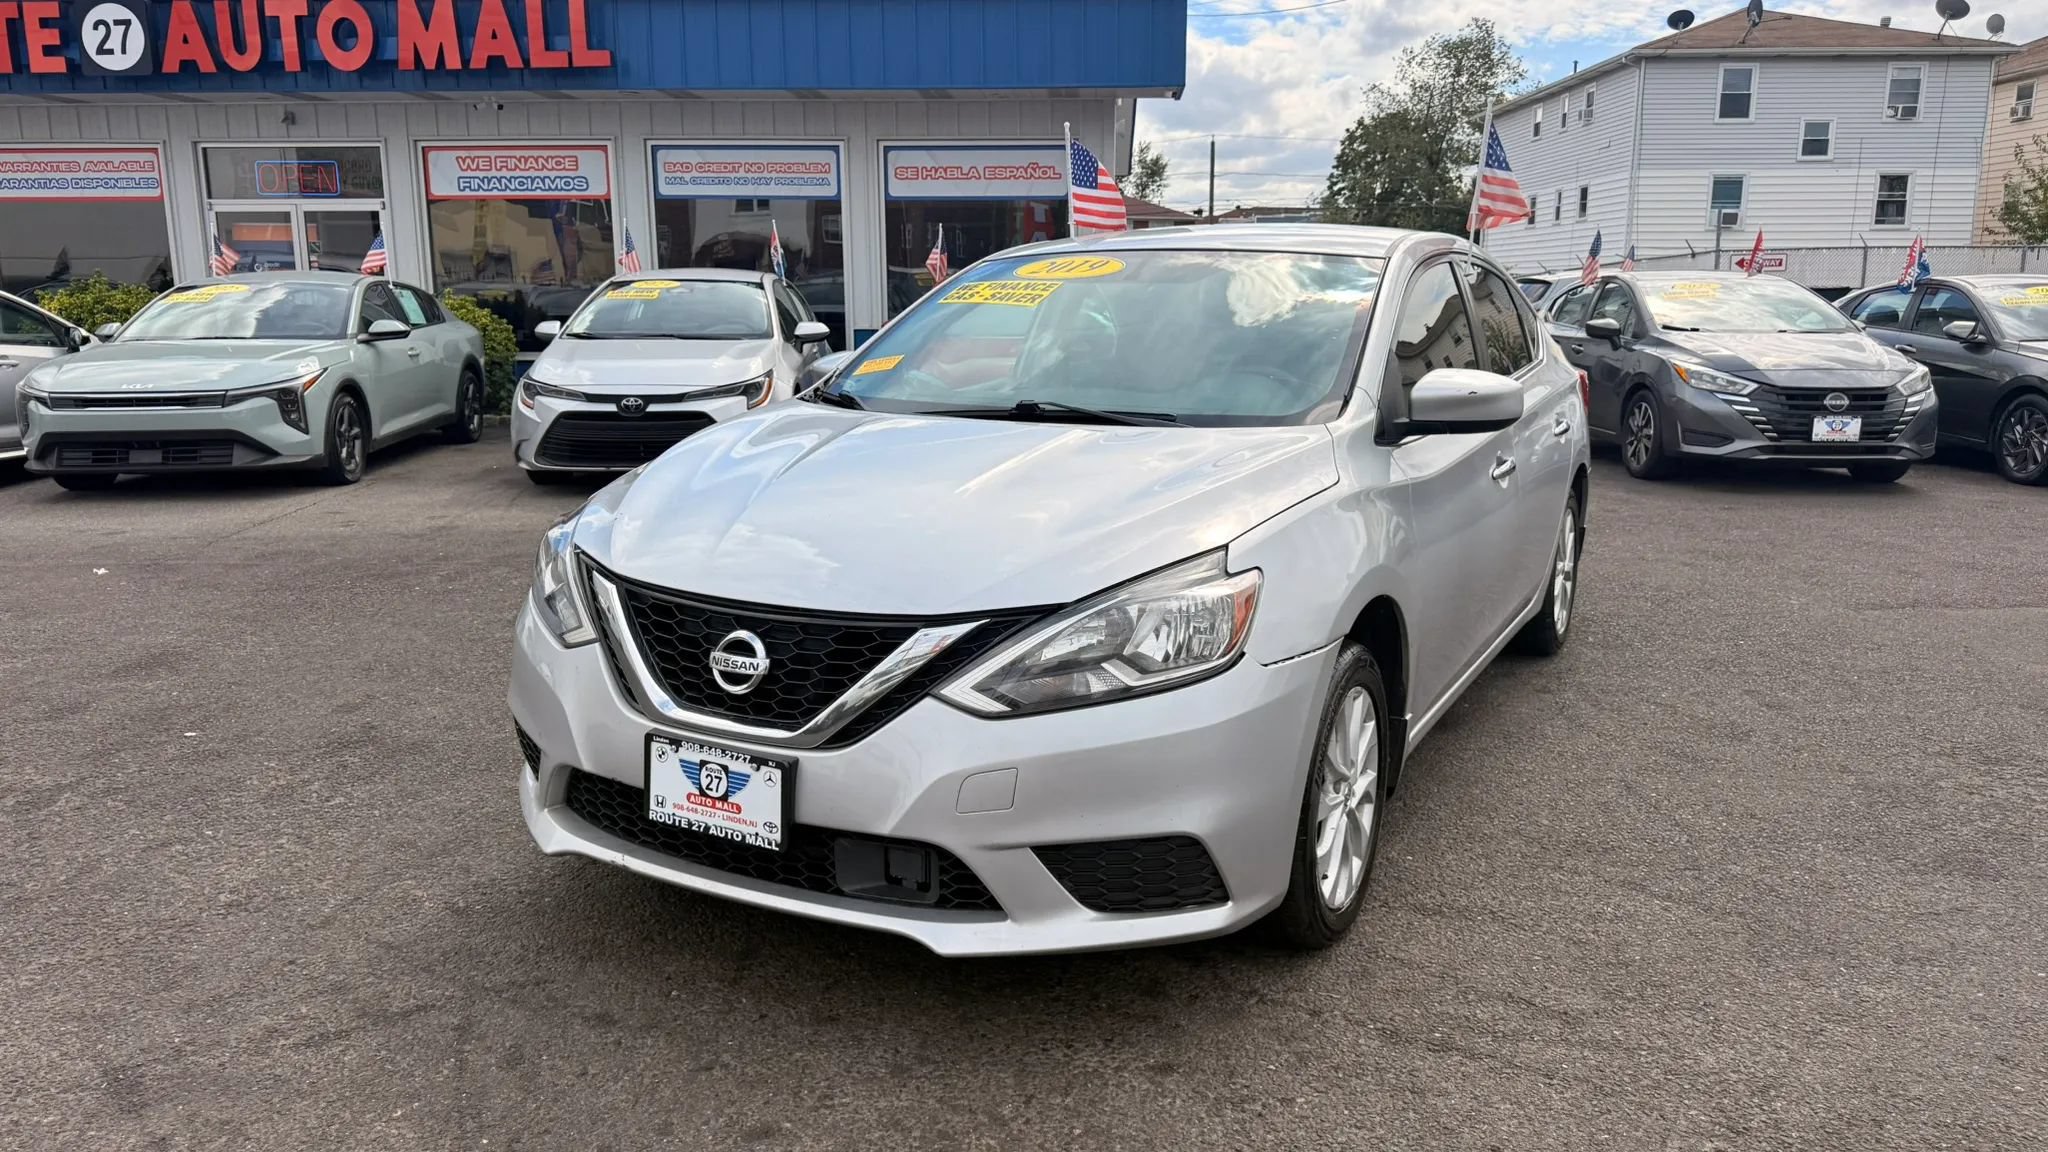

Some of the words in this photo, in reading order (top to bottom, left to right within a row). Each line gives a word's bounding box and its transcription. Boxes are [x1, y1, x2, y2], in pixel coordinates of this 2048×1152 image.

[92, 19, 132, 56] 27
[161, 0, 374, 73] AUTO
[397, 0, 611, 71] MALL
[83, 161, 155, 173] AVAILABLE
[456, 155, 492, 172] WE
[494, 155, 578, 172] FINANCE
[664, 162, 692, 174] BAD
[695, 162, 742, 174] CREDIT
[744, 162, 765, 174] NO
[766, 162, 831, 174] PROBLEM
[895, 166, 919, 180] SE
[921, 166, 981, 180] HABLA
[984, 162, 1062, 180] ESPAÑOL
[0, 178, 69, 189] ARANTIAS
[71, 178, 159, 189] DISPONIBLES
[258, 164, 337, 193] OPEN
[457, 176, 589, 192] FINANCIAMOS
[665, 176, 688, 186] MAL
[690, 176, 732, 186] CREDITO
[734, 176, 750, 186] NO
[751, 176, 774, 186] HAY
[775, 176, 831, 186] PROBLEMA
[1029, 259, 1112, 275] 2019
[957, 283, 983, 292] WE
[983, 282, 1058, 293] FINANCE
[943, 291, 978, 301] GAS
[985, 291, 1045, 304] SAVER
[711, 655, 760, 672] NISSAN
[681, 741, 751, 764] 908-648-2727
[705, 766, 723, 776] ROUTE
[705, 773, 723, 794] 27
[672, 803, 716, 819] 908-648-2727
[690, 795, 713, 807] AUTO
[715, 799, 739, 813] MALL
[649, 809, 689, 829] ROUTE
[691, 820, 706, 833] 27
[708, 825, 743, 842] AUTO
[745, 834, 780, 851] MALL
